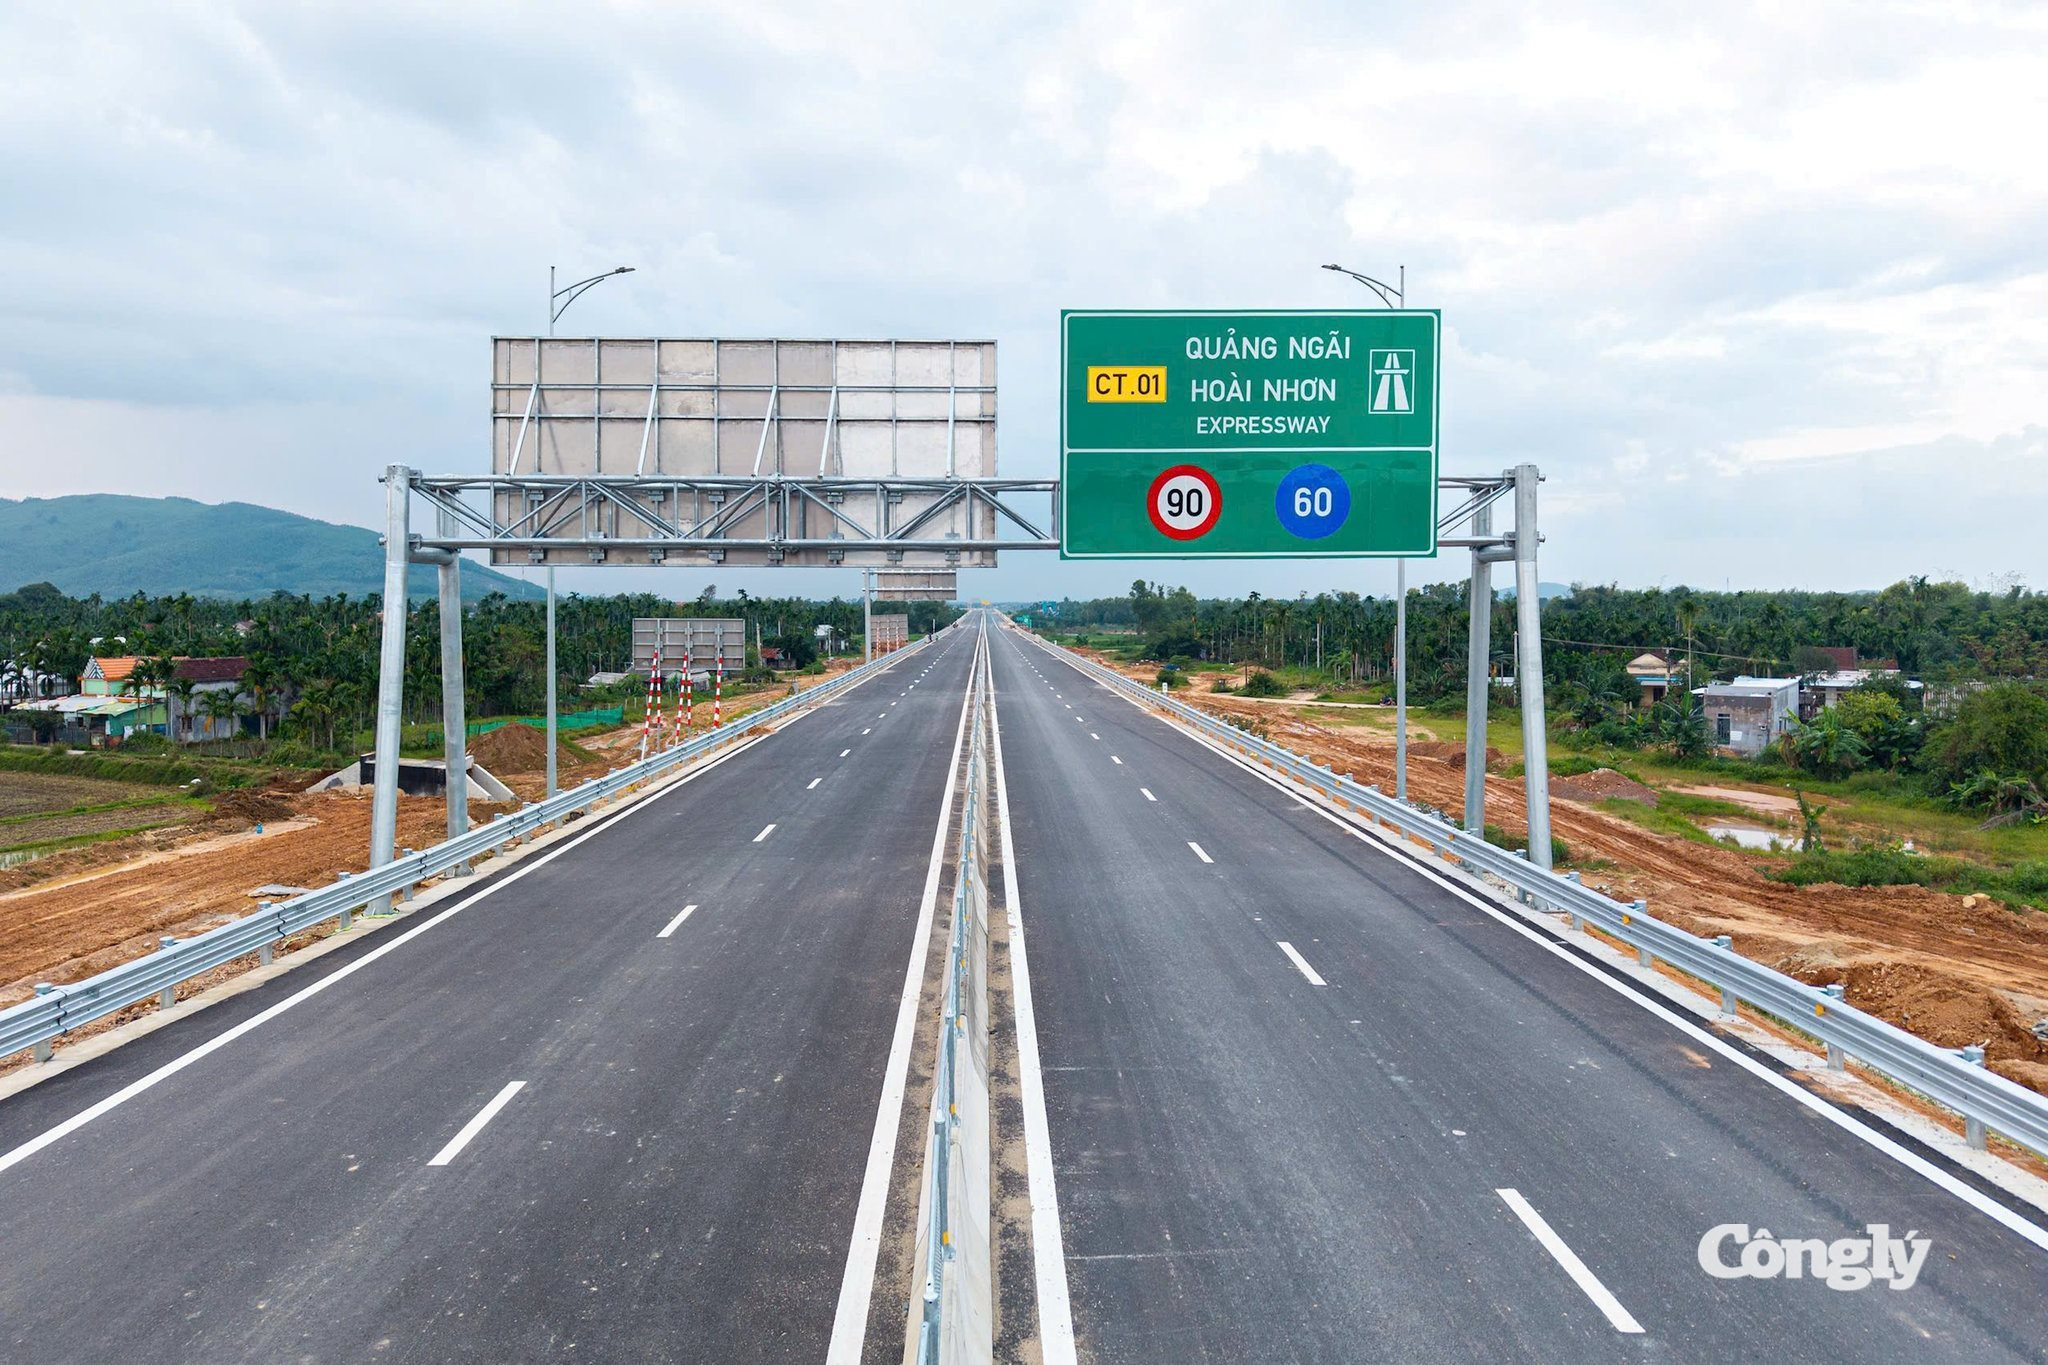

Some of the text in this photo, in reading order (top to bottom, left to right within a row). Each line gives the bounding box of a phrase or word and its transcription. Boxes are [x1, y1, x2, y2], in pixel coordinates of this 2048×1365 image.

[1186, 328, 1351, 360] QUẢNG NGÃI
[1191, 372, 1336, 402] HOÀI NHƠN
[1196, 416, 1331, 434] EXPRESSWAY
[1167, 488, 1203, 517] 90
[1294, 487, 1332, 517] 60
